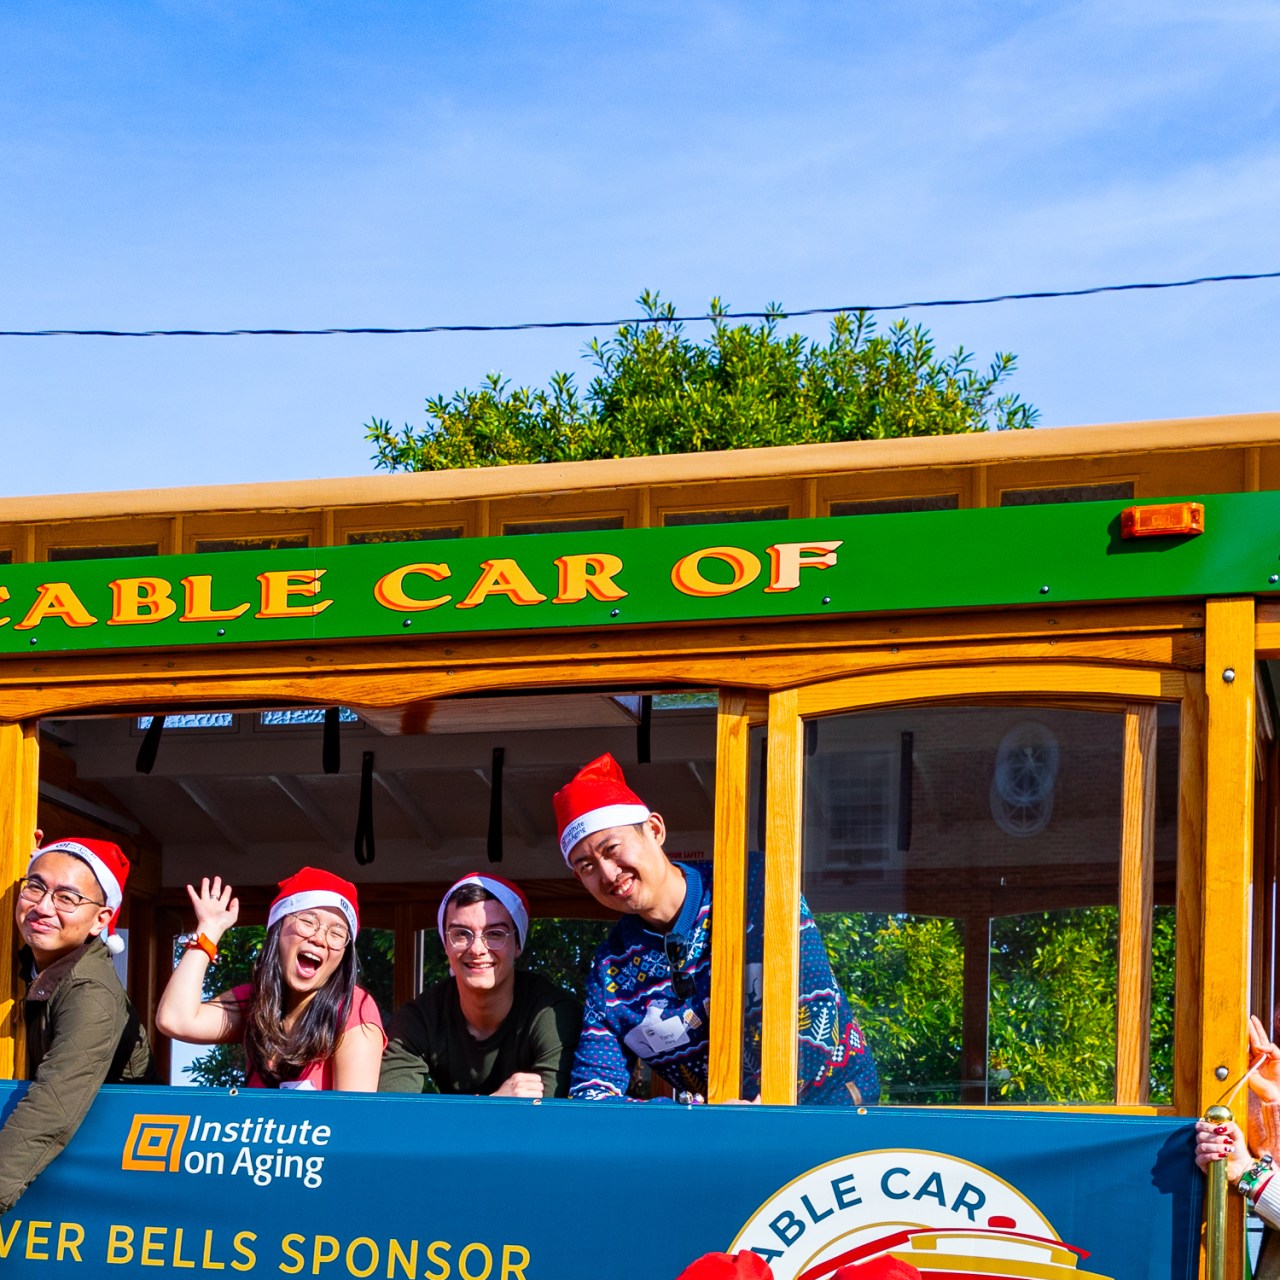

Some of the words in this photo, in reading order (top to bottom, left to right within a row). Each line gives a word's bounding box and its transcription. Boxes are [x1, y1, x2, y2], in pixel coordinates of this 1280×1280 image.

[373, 553, 629, 612] CAR
[670, 540, 844, 598] OF
[188, 1114, 331, 1147] Institute
[184, 1147, 224, 1176] on
[231, 1145, 325, 1189] Aging
[750, 1173, 863, 1265] ABLE
[880, 1166, 987, 1222] CAR
[106, 1224, 258, 1273] BELLS
